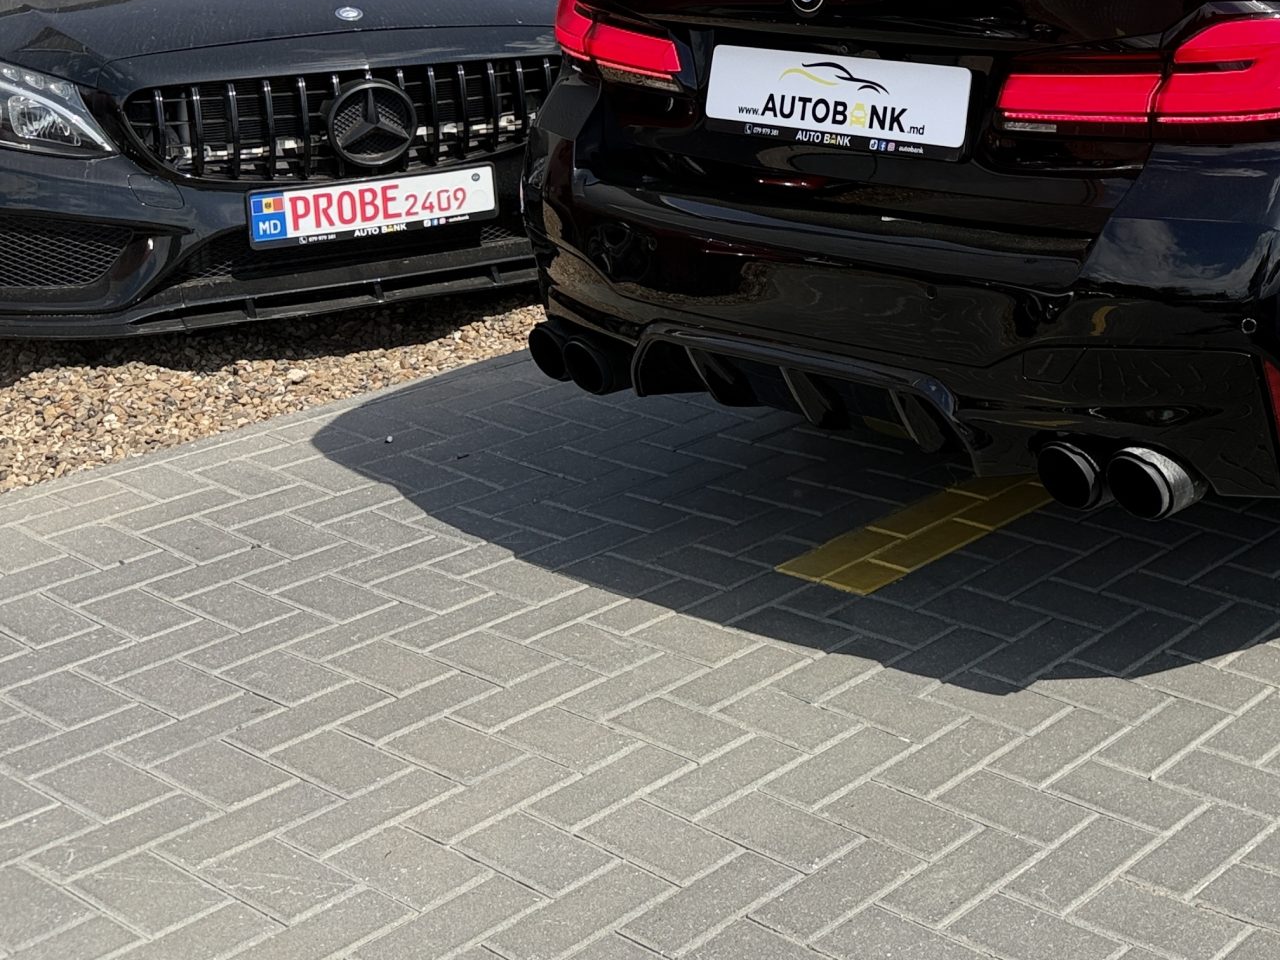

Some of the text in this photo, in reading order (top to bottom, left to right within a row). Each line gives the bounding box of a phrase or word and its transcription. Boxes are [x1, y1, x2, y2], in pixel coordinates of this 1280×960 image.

[795, 130, 851, 147] AUTO BANK
[289, 184, 467, 232] PROBE 2409
[258, 218, 281, 236] MD
[353, 222, 408, 238] AUTO BANK
